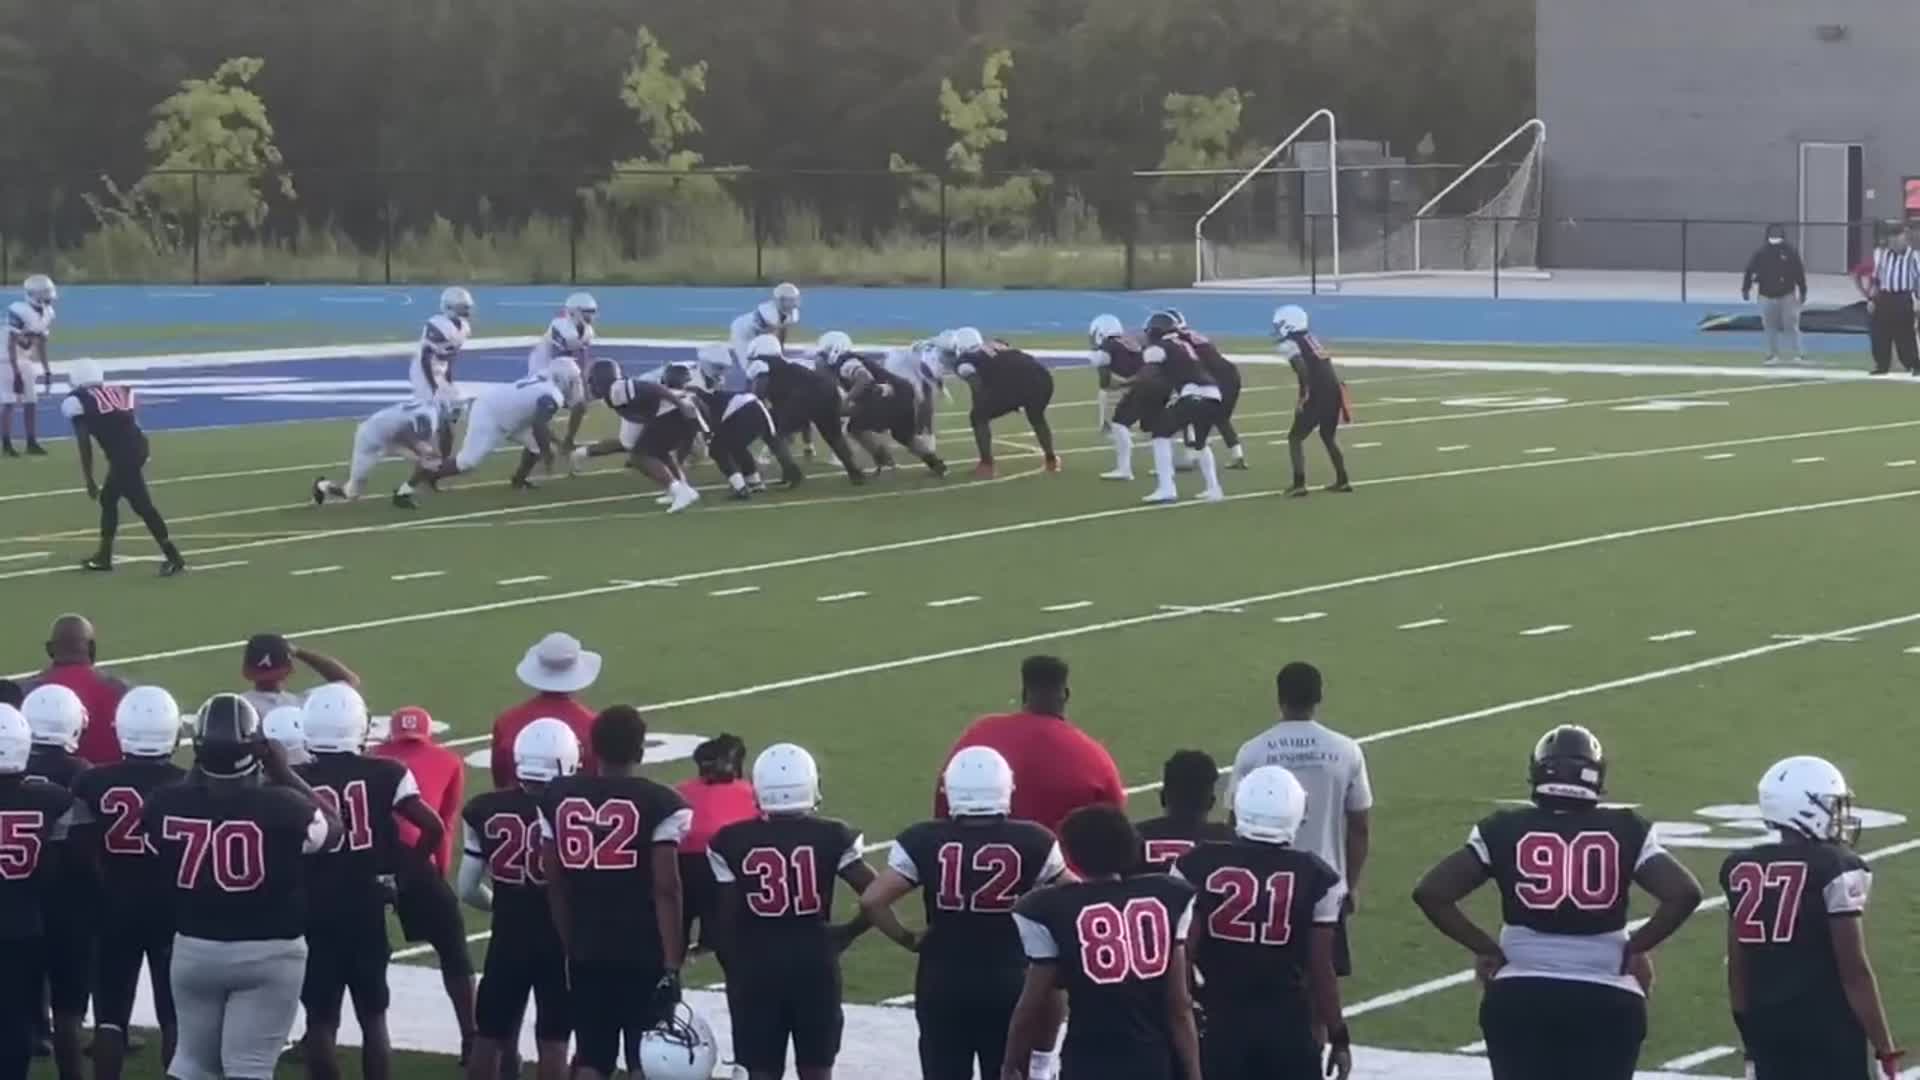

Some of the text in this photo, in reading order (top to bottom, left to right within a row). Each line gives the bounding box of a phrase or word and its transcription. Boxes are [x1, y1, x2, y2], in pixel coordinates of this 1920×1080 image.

[162, 816, 265, 892] 70
[556, 797, 640, 869] 62
[1515, 831, 1620, 910] 90
[743, 846, 821, 917] 31
[937, 842, 1022, 912] 12
[1205, 867, 1295, 945] 21
[1729, 862, 1807, 943] 27
[1076, 897, 1171, 985] 80
